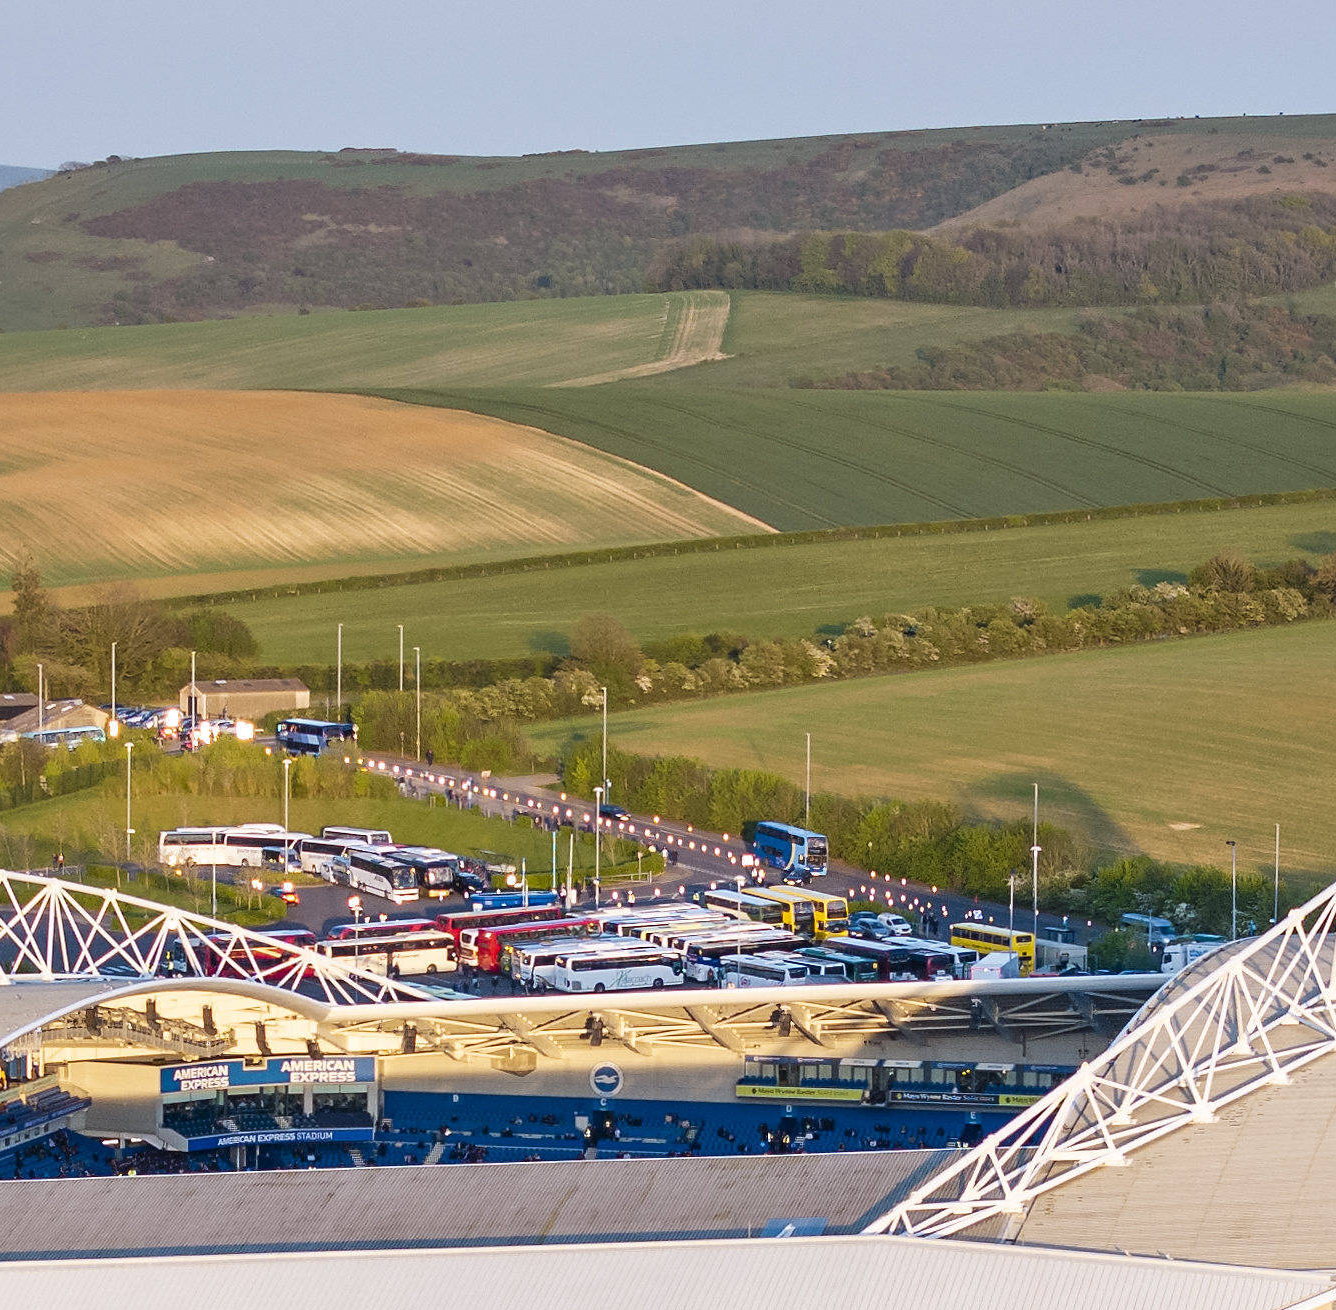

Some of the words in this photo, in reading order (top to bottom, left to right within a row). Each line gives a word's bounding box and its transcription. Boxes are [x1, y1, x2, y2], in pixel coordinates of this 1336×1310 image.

[281, 1060, 355, 1072] AMERICAN
[173, 1065, 229, 1081] AMERICAN
[290, 1071, 356, 1083] EXPRESS
[181, 1077, 229, 1091] EXPRESS
[600, 1098, 607, 1106] C
[970, 1112, 976, 1120] E
[217, 1135, 256, 1147] AMERICAN
[258, 1133, 295, 1142] EXPRESS
[296, 1132, 333, 1141] STADIUM
